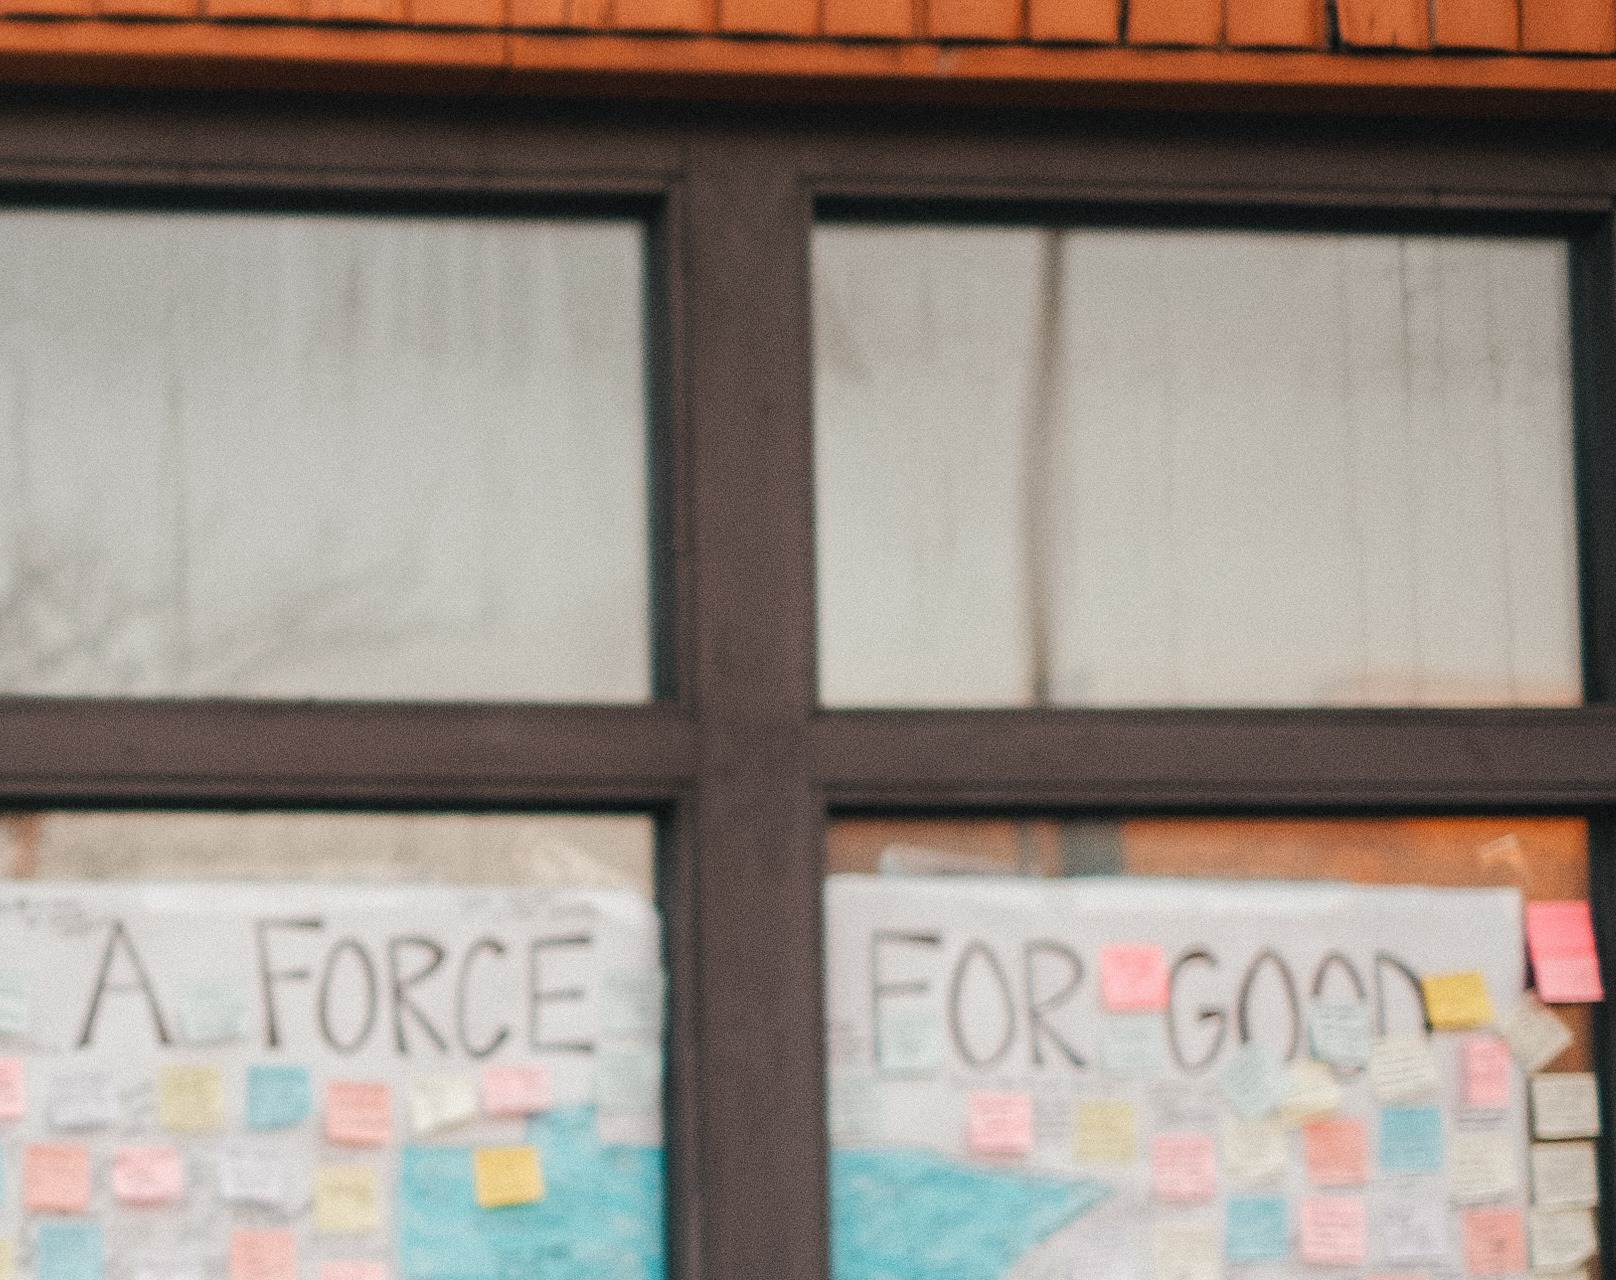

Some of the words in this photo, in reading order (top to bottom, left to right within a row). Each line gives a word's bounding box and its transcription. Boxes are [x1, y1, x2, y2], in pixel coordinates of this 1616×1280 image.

[77, 920, 173, 1048] A
[256, 919, 595, 1057] FORCE
[872, 931, 1087, 1070] FOR
